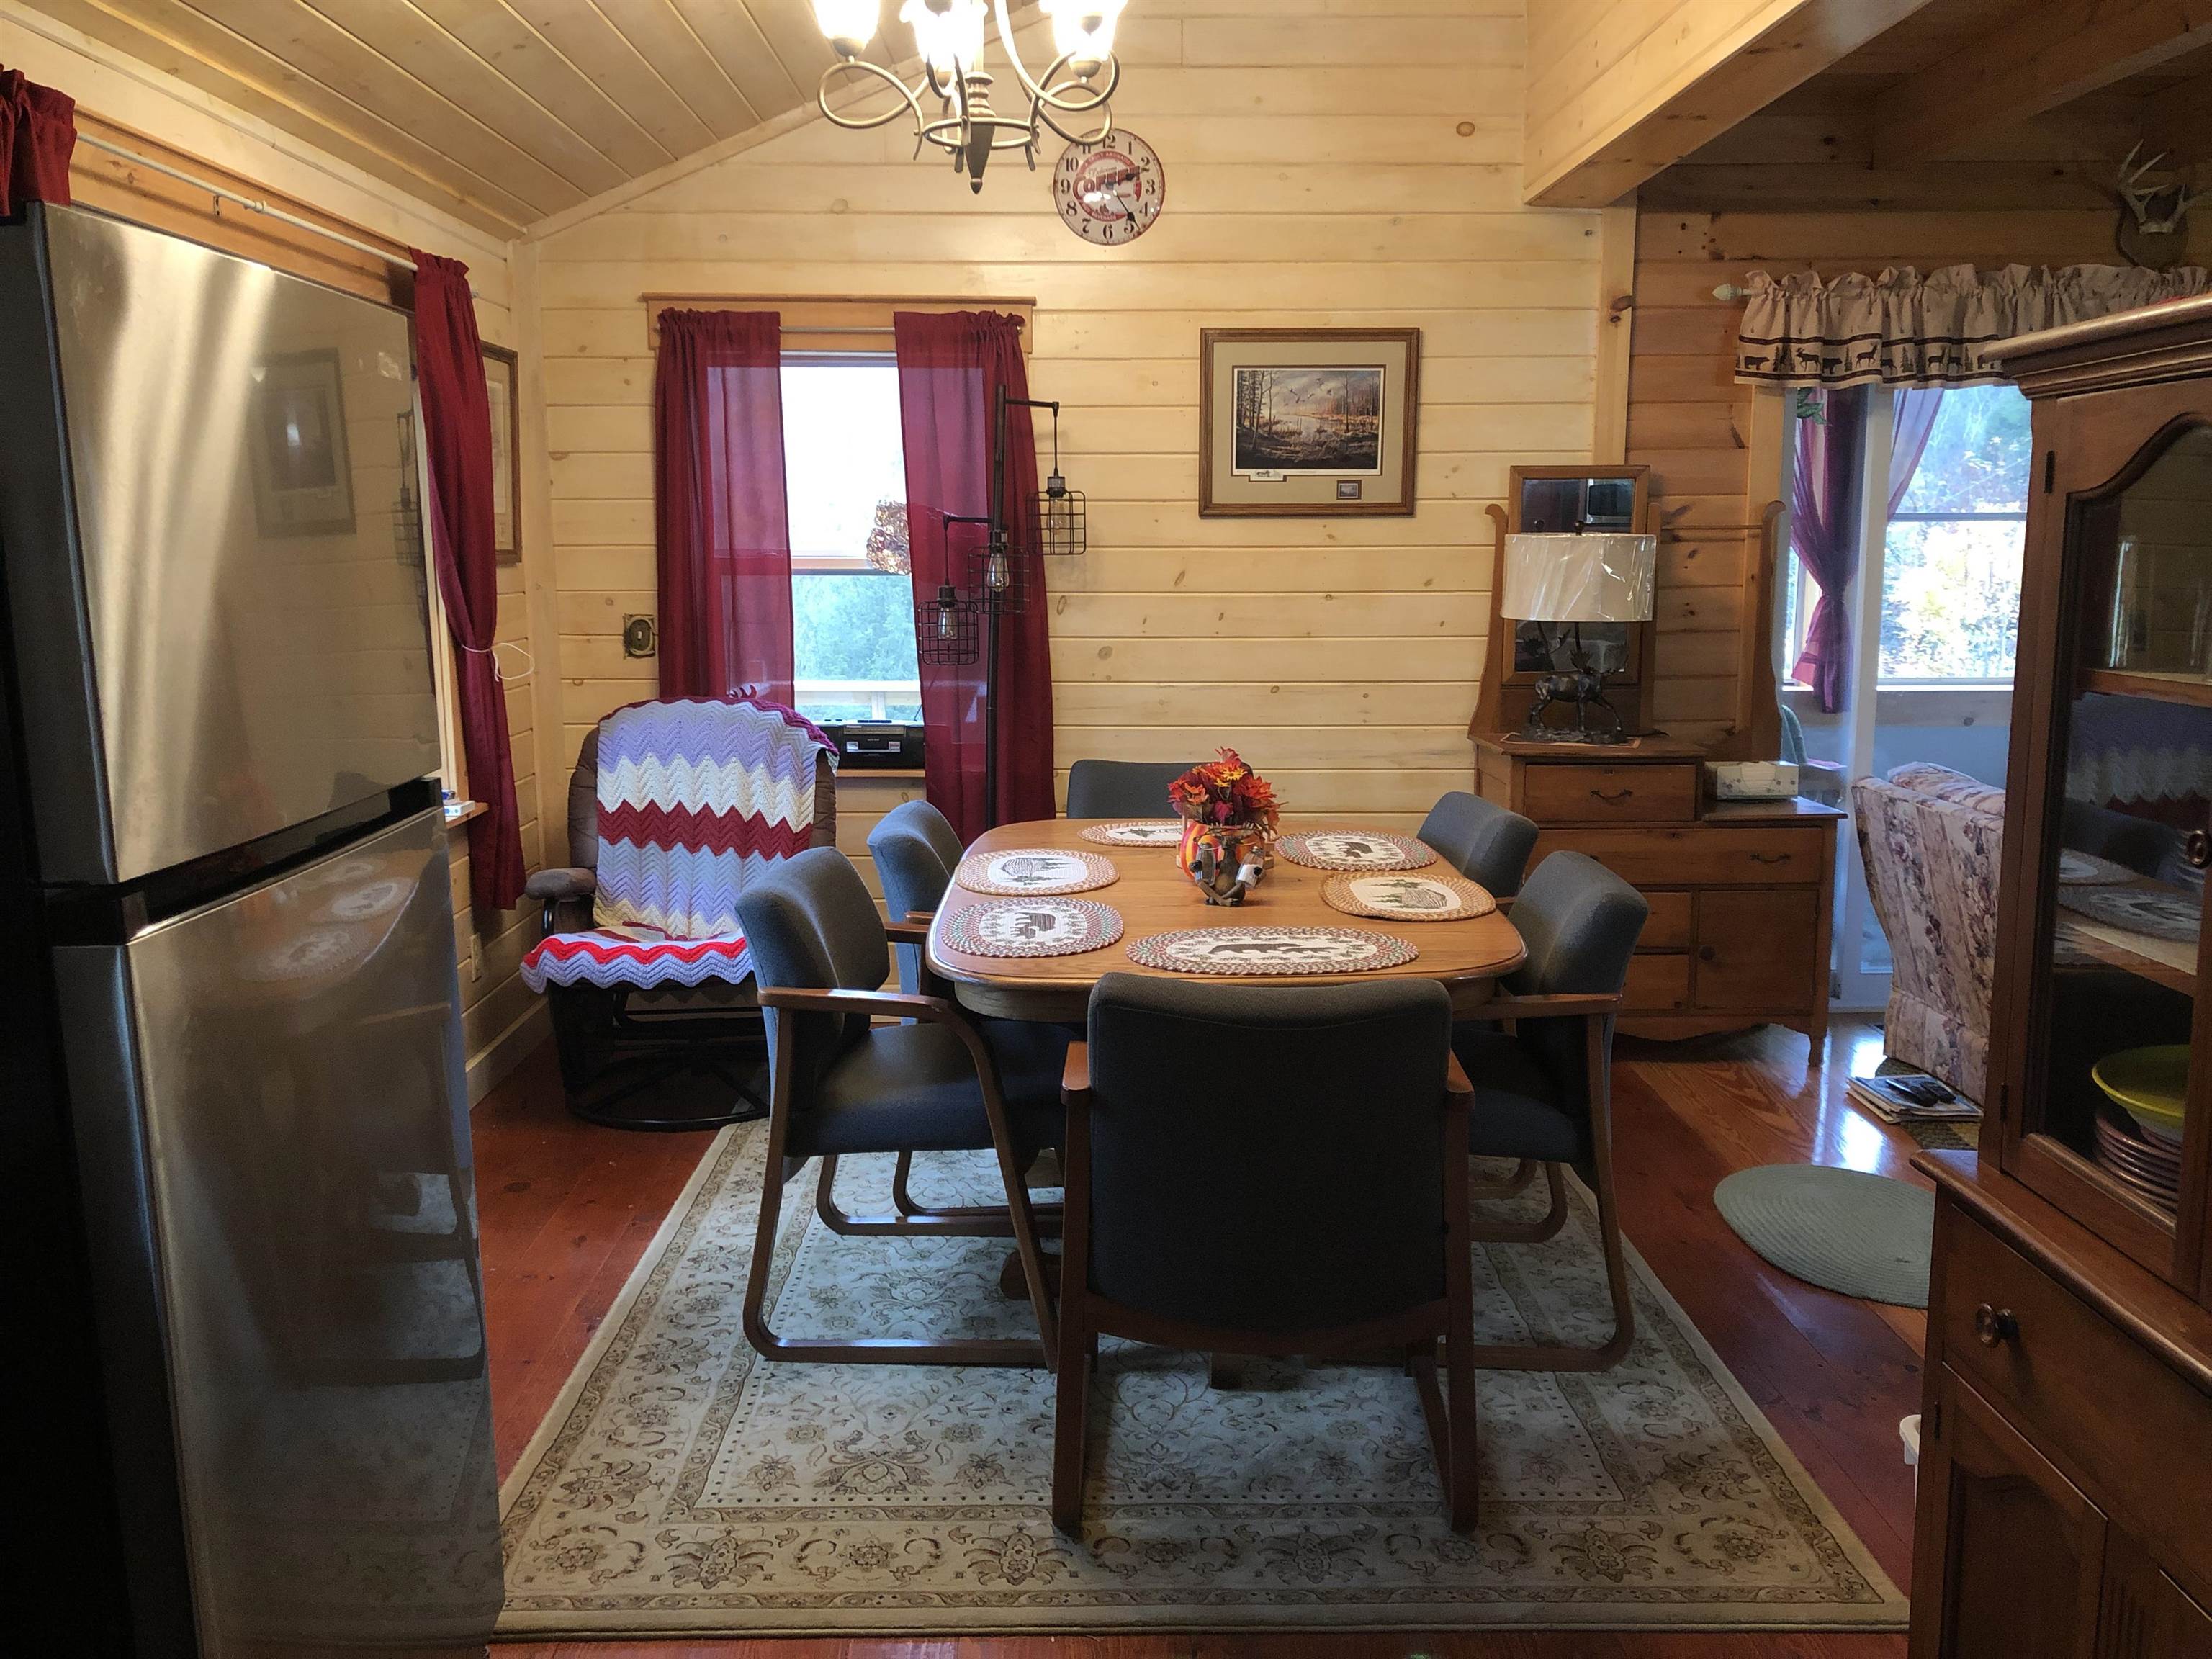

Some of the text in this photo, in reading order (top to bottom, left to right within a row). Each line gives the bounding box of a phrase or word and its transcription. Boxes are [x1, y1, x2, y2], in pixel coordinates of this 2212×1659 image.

[1102, 135, 1116, 148] 12
[1128, 141, 1133, 155] 1
[1066, 157, 1079, 172] 10
[1141, 156, 1151, 172] 2
[1061, 178, 1071, 194] 9
[1145, 179, 1156, 195] 3
[1066, 201, 1078, 217] 8
[1139, 202, 1148, 217] 4
[1082, 218, 1092, 233] 7
[1102, 224, 1113, 239] 6
[1124, 219, 1135, 234] 5
